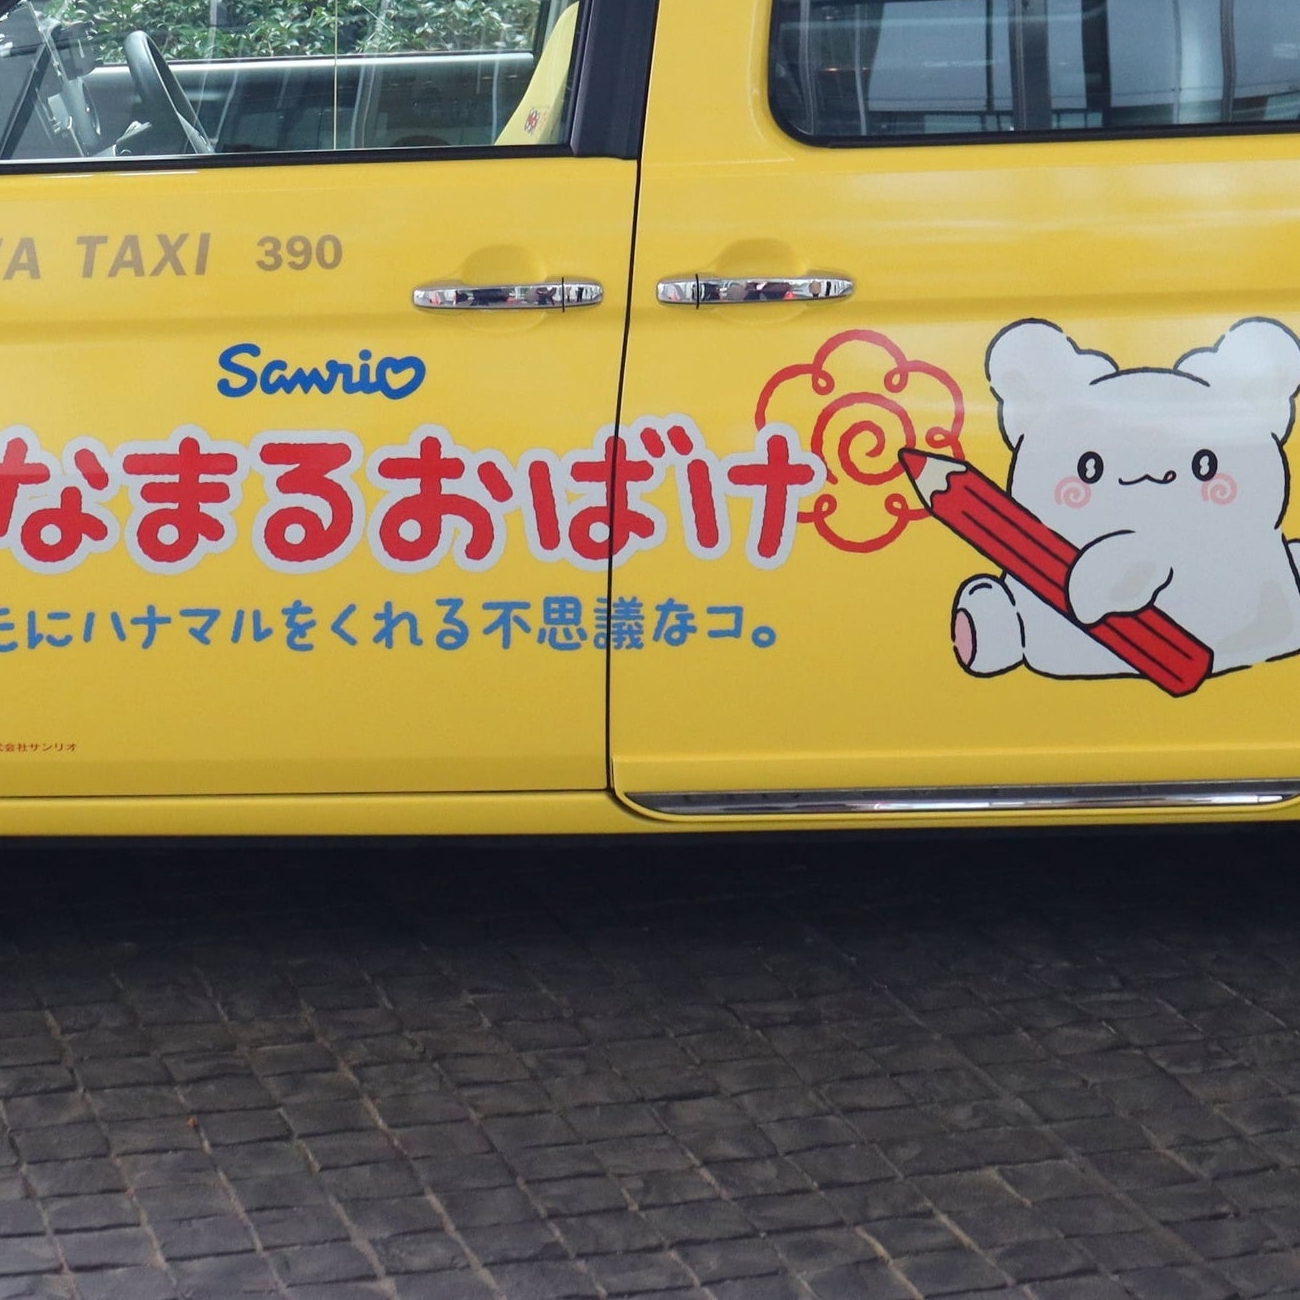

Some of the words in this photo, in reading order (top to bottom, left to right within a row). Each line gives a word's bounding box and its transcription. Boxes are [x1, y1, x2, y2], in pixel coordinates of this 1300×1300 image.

[74, 231, 213, 280] TAXI
[255, 233, 345, 273] 390
[216, 342, 427, 401] Sanrio
